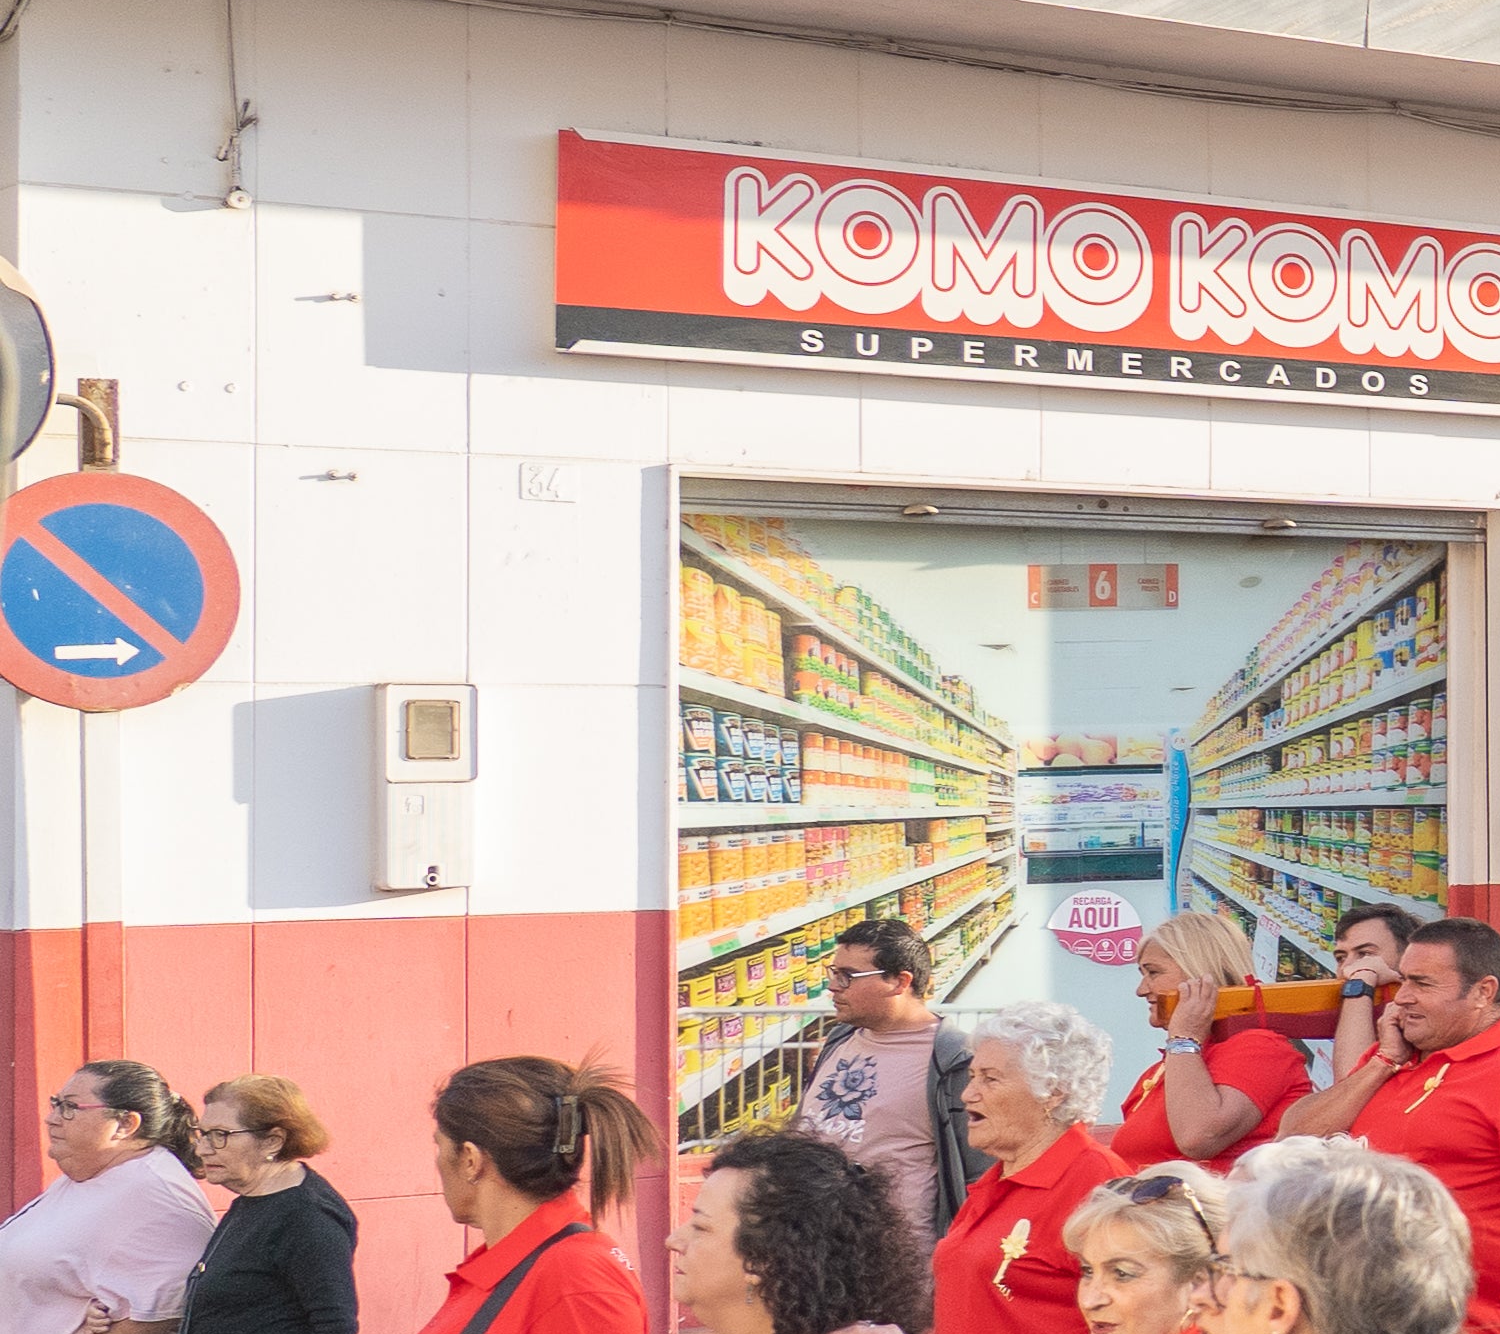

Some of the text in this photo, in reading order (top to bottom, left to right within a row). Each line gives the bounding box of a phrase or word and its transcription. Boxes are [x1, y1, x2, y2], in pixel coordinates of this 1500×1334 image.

[723, 166, 1153, 333] KOMO
[799, 329, 1429, 396] SUPERMERCADOS
[1095, 571, 1112, 601] 6
[1068, 901, 1121, 930] AQUÍ
[1073, 897, 1112, 906] RECARGA
